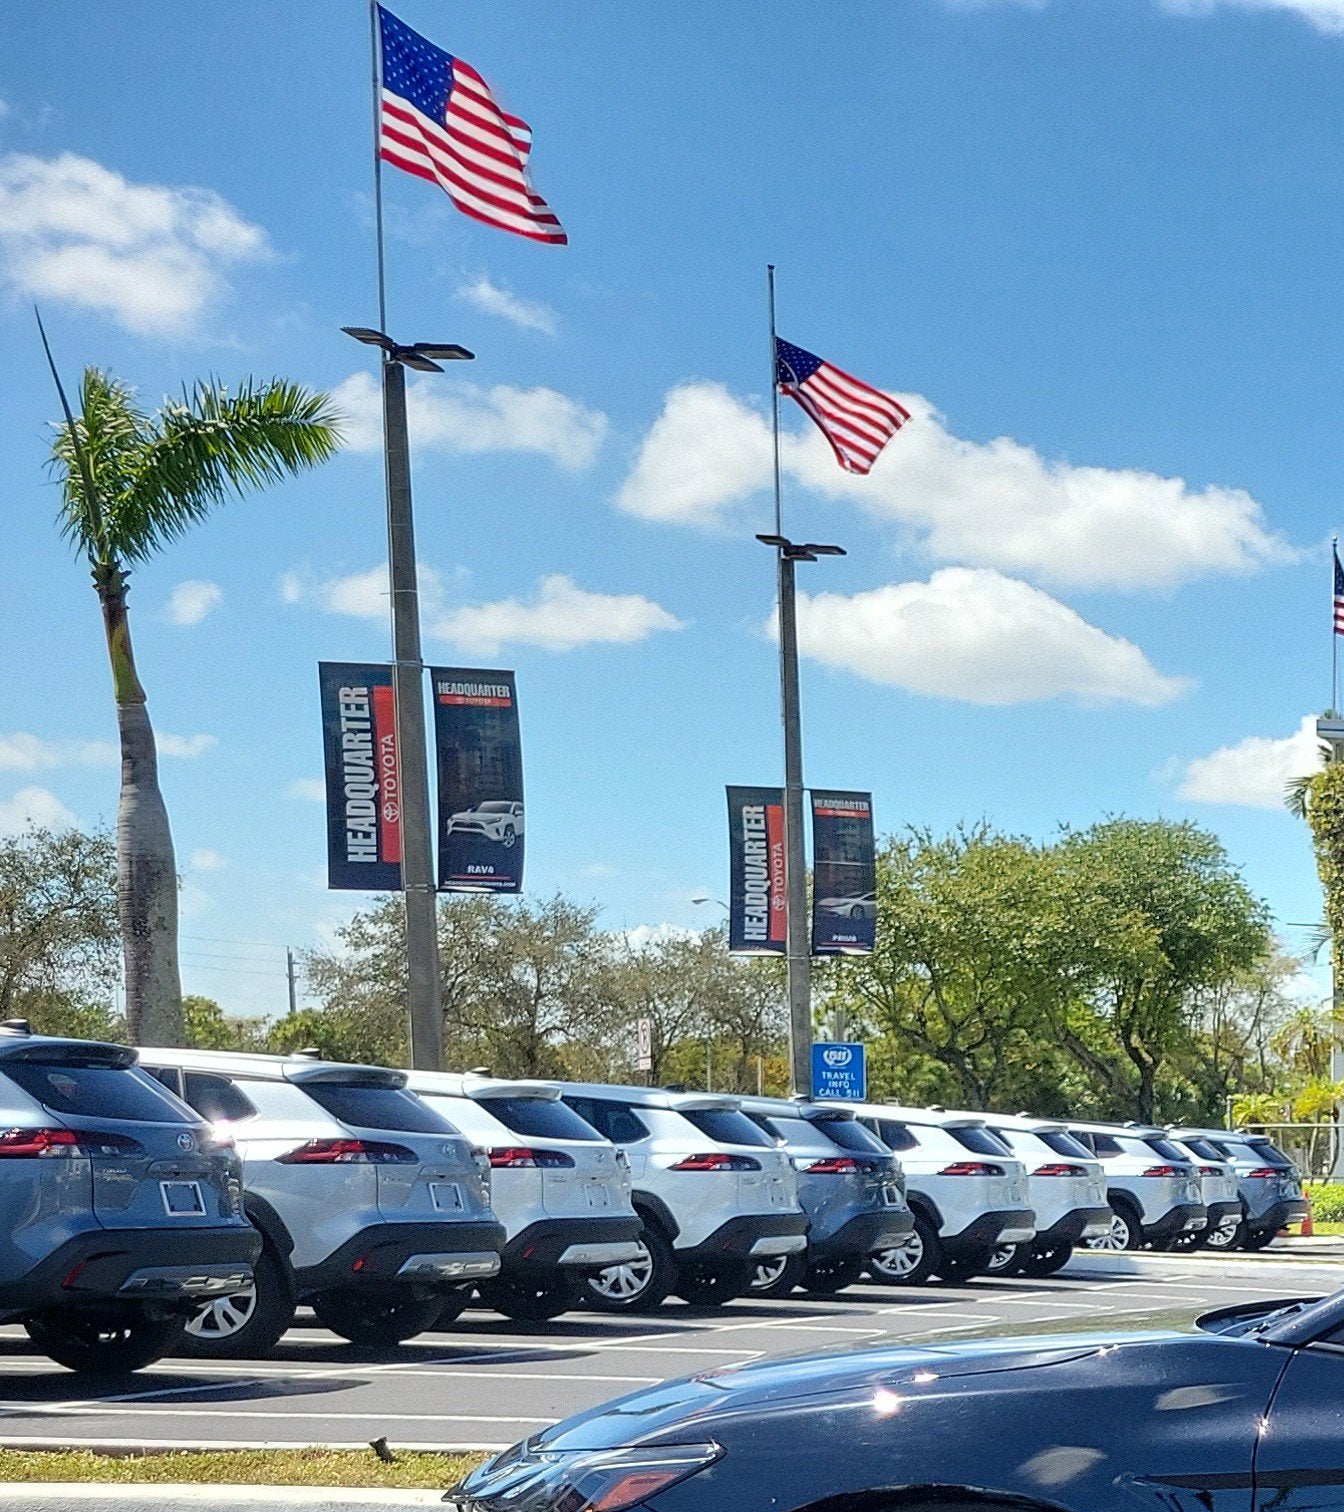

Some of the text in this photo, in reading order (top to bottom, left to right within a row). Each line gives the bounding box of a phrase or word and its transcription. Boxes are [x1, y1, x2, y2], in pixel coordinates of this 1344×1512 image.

[437, 682, 511, 698] HEADQUARTER
[339, 687, 379, 862] HEADQUARTER
[381, 734, 397, 800] TOYOTA
[467, 865, 495, 874] RAV4
[742, 805, 772, 941] HEADQUARTER
[772, 843, 785, 893] TOYOTA
[822, 1071, 856, 1080] TRAVEL
[818, 1088, 842, 1097] CALL
[828, 1080, 850, 1089] INFO
